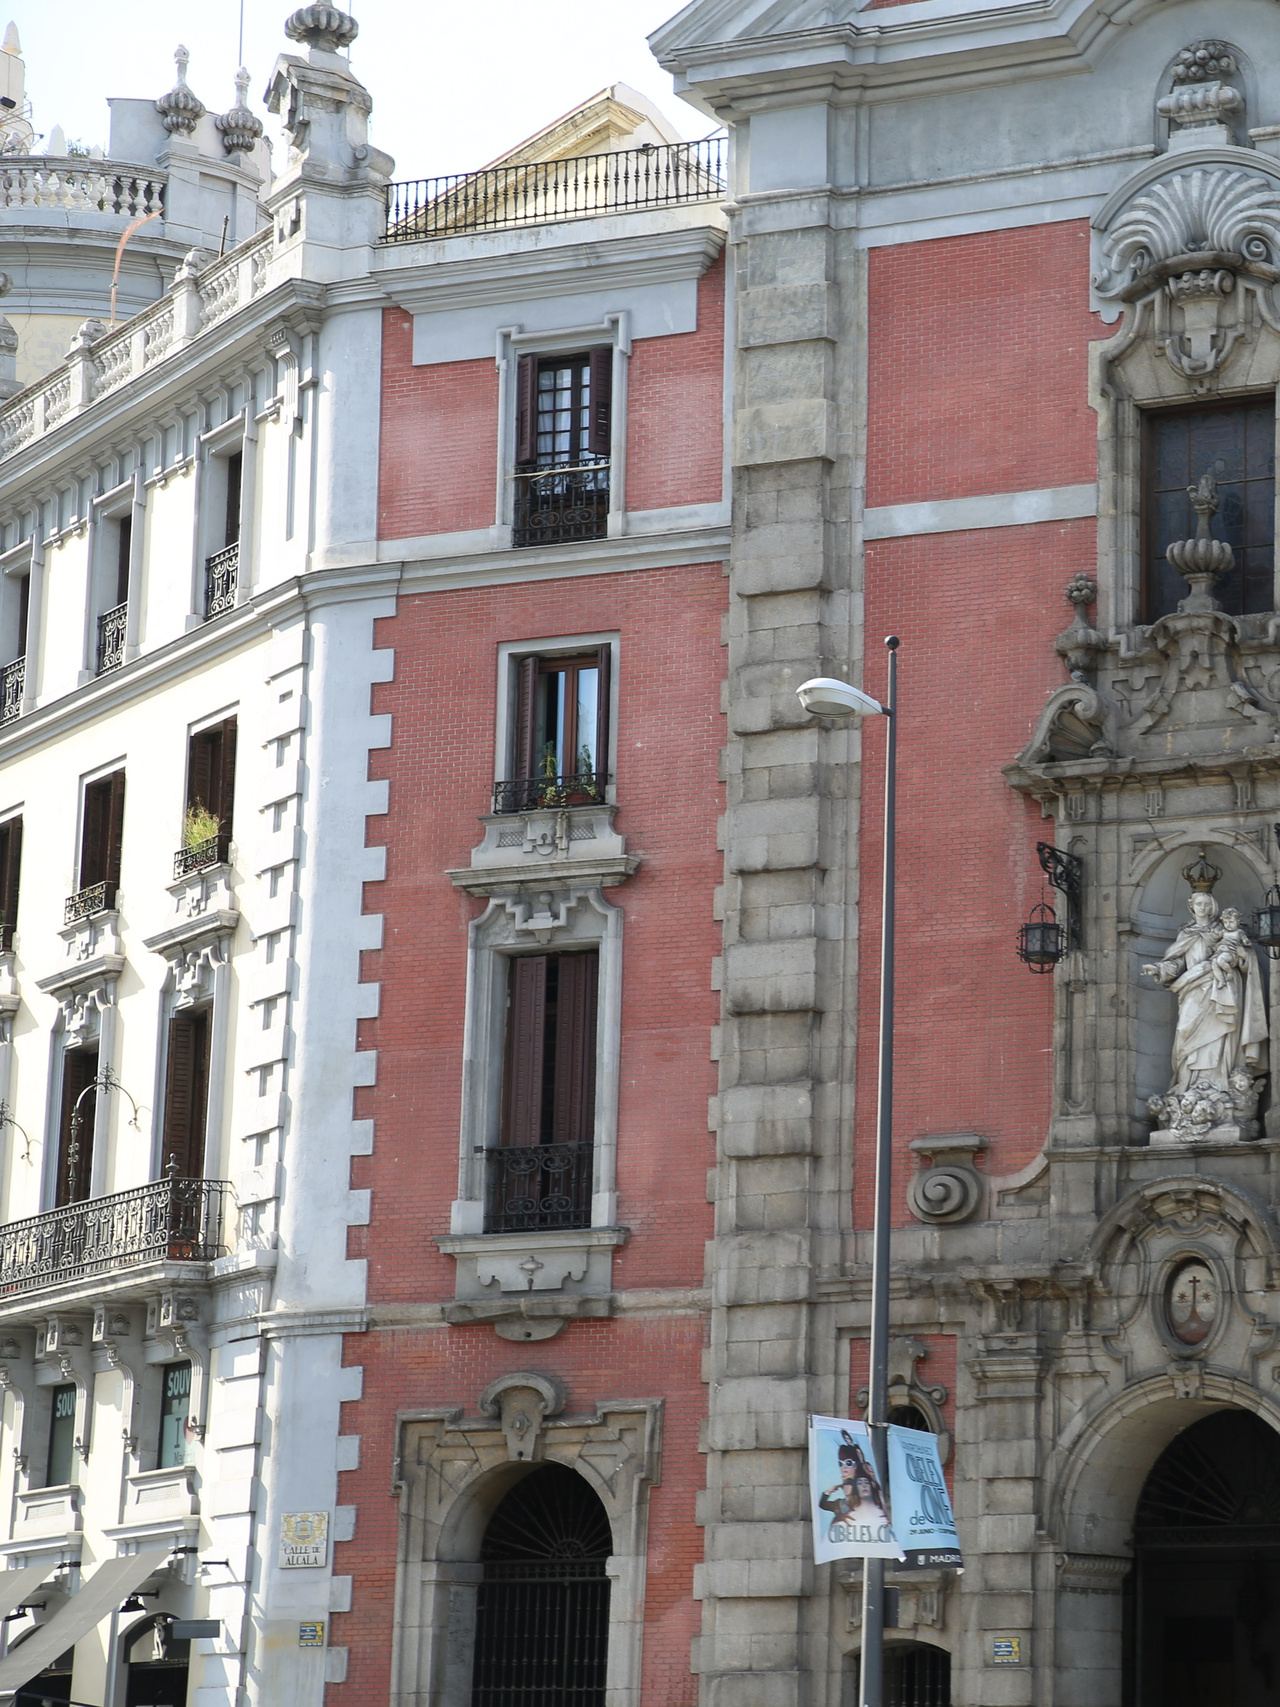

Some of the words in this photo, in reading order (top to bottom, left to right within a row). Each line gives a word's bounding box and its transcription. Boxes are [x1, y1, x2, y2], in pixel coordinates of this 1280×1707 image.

[909, 1510, 926, 1526] de
[284, 1546, 310, 1555] CALLE
[312, 1546, 322, 1554] DE
